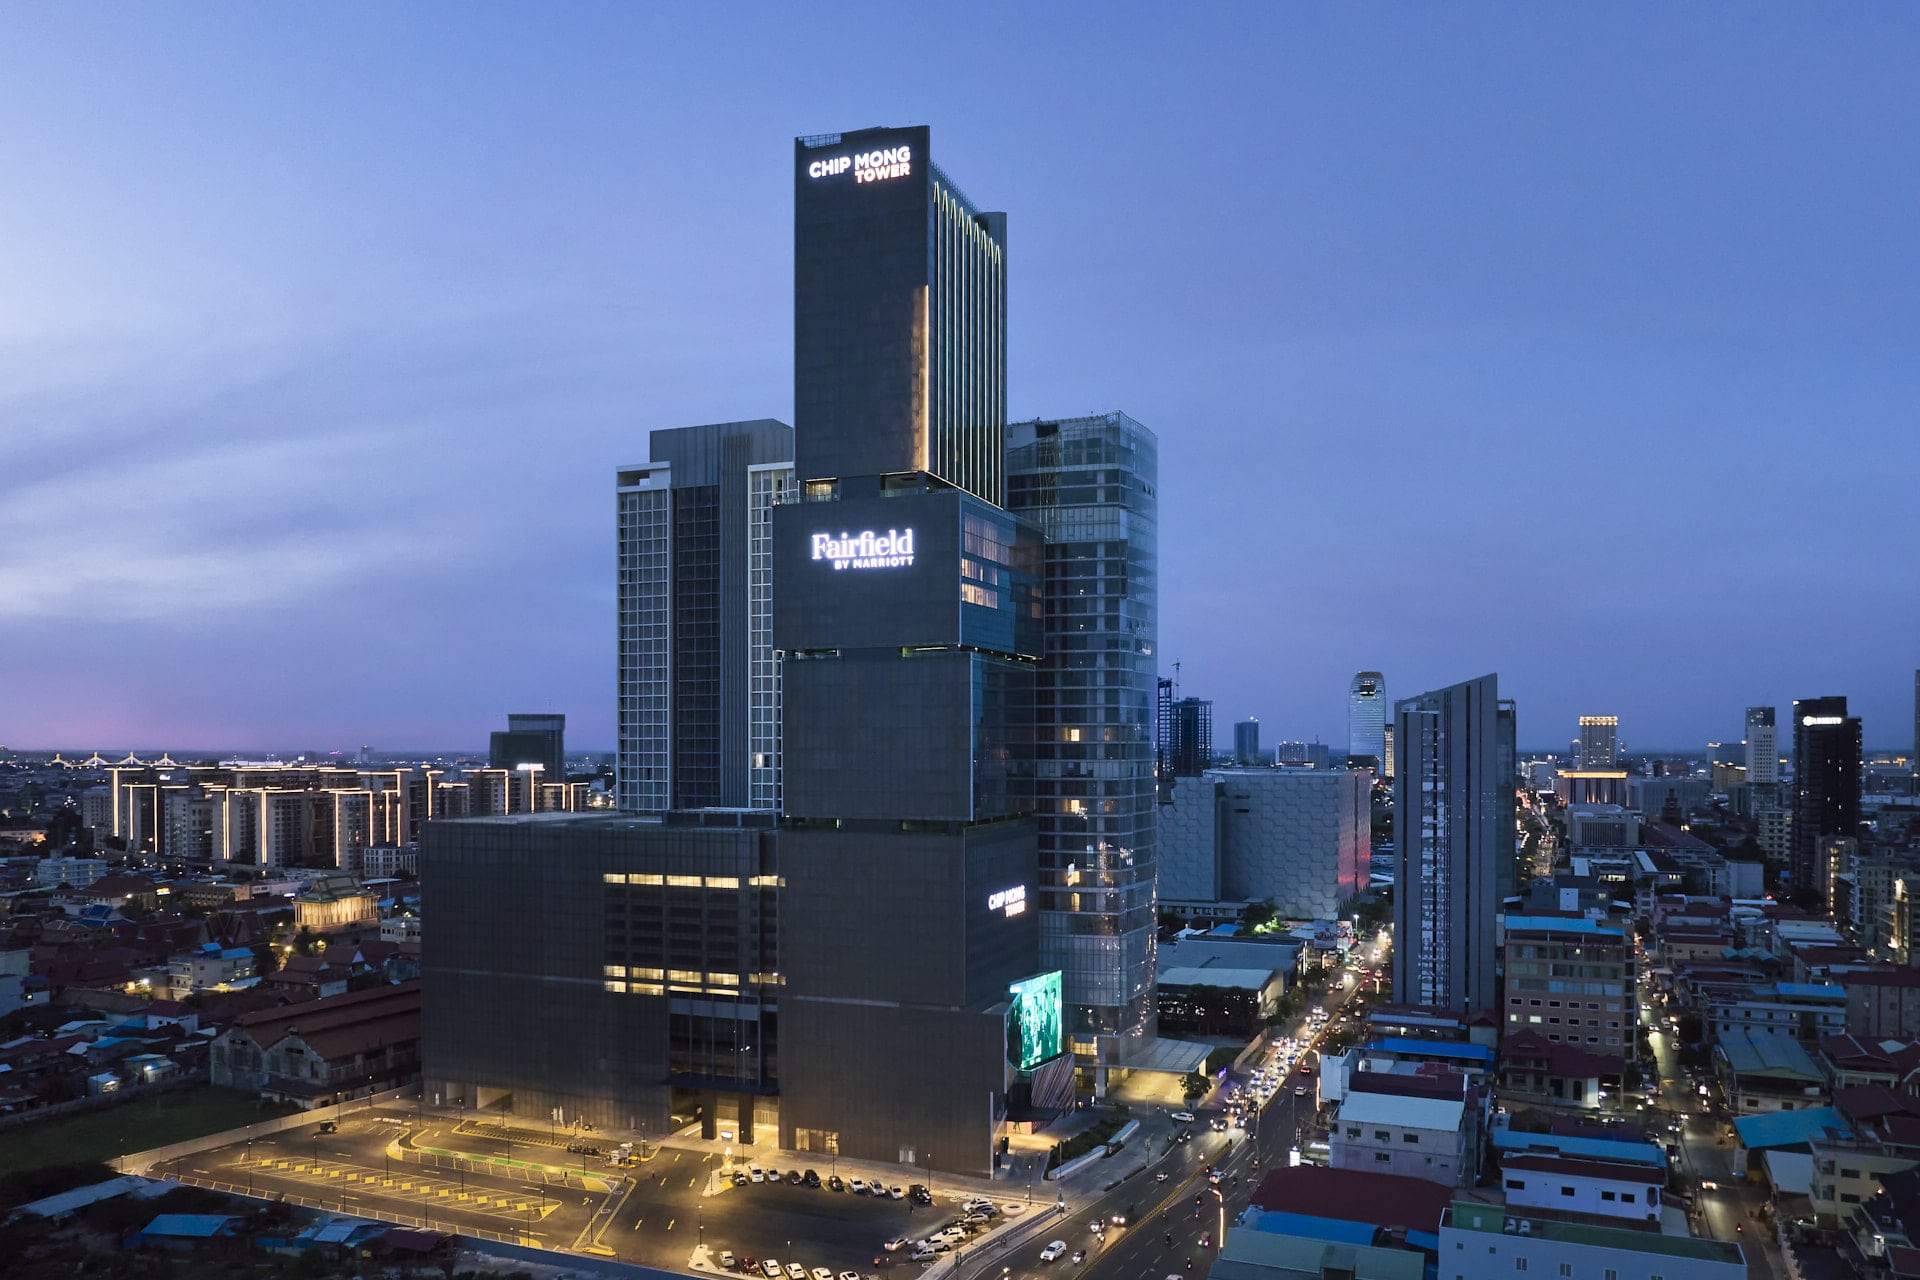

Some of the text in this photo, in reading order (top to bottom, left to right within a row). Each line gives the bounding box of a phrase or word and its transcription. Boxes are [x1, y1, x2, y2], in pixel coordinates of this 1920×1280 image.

[809, 146, 911, 178] CHIP MONG
[854, 162, 911, 184] TOWER
[811, 528, 914, 560] Fairfield
[834, 556, 914, 570] BY MARRIOTT
